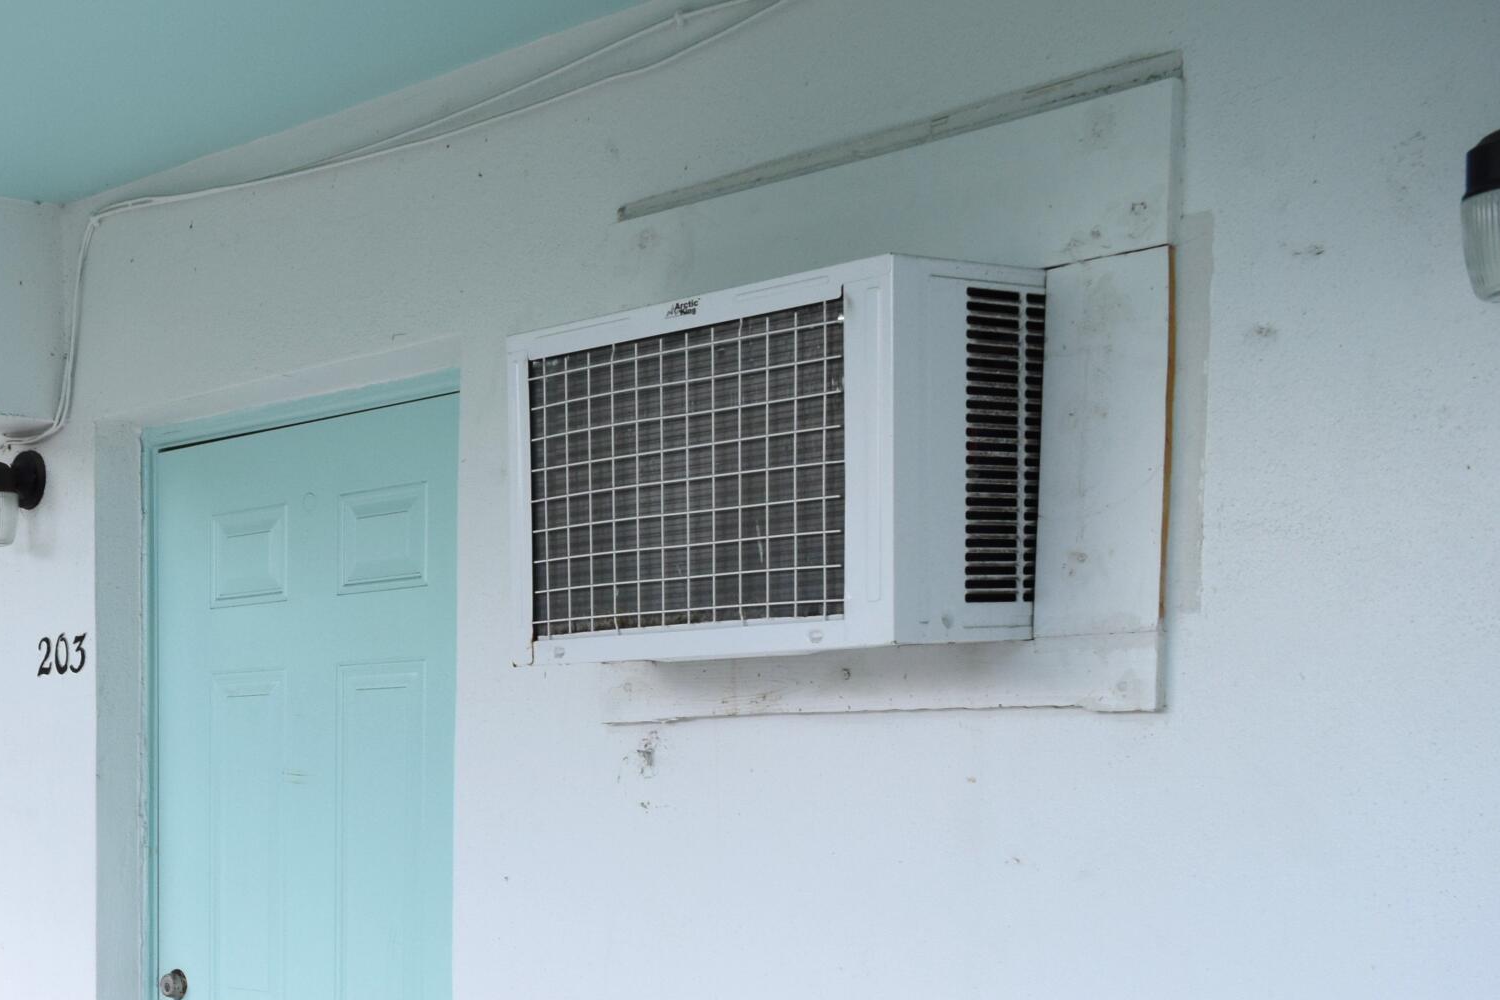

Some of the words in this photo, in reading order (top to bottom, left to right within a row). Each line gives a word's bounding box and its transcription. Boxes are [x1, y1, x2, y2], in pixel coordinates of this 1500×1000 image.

[675, 299, 699, 310] Arctic
[679, 308, 696, 316] King
[37, 632, 87, 676] 203
